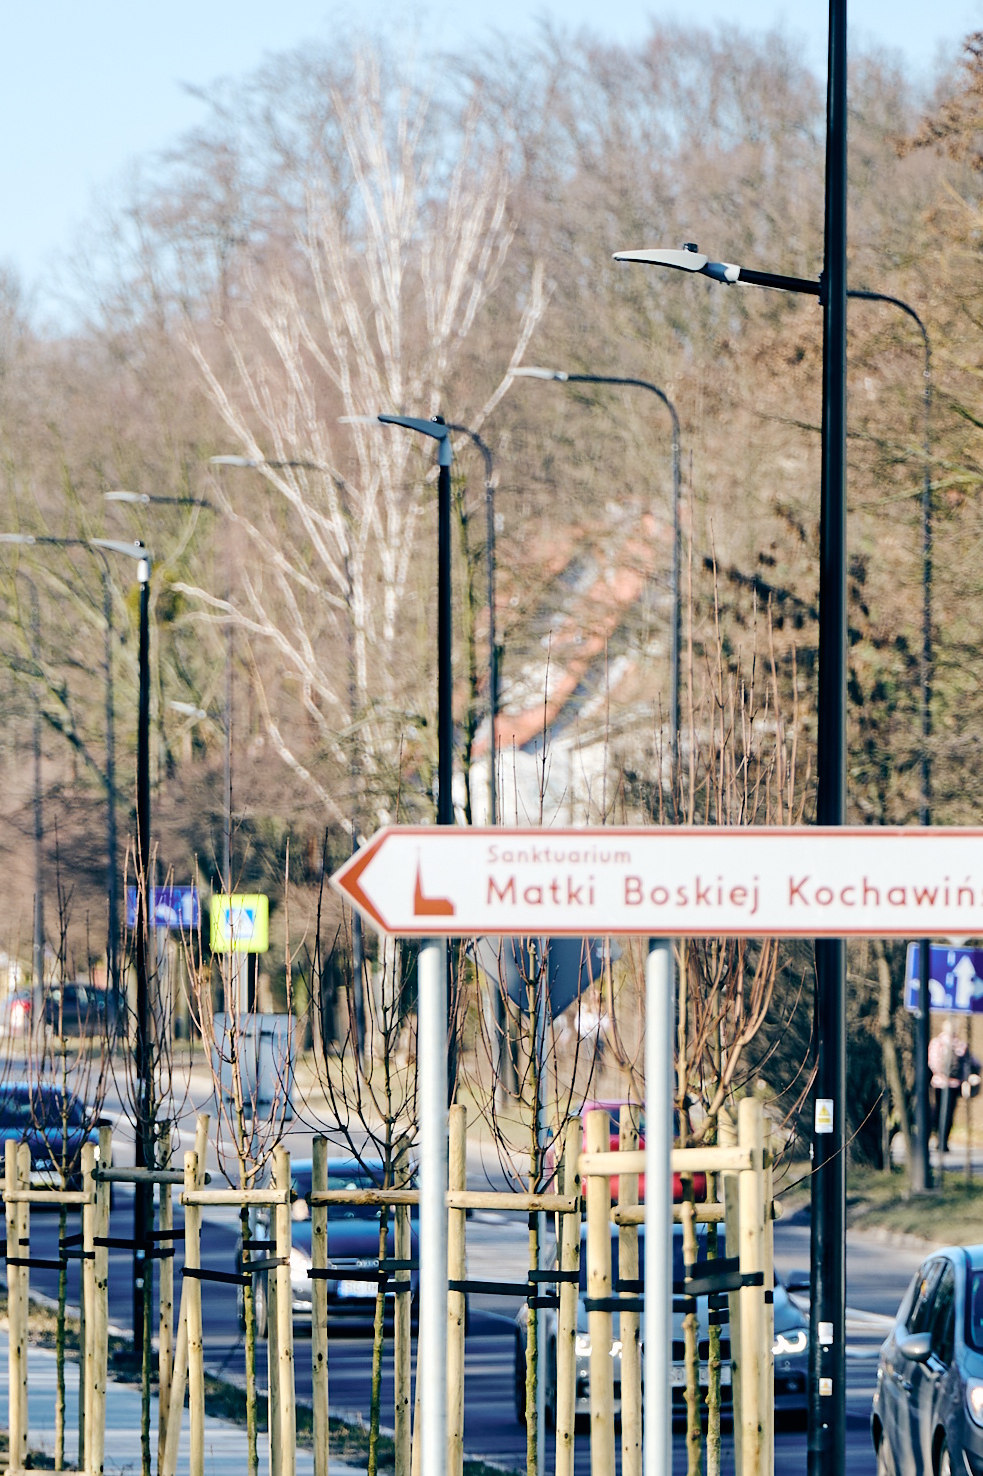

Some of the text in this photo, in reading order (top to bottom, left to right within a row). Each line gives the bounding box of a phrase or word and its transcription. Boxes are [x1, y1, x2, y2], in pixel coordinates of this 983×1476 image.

[487, 845, 631, 864] Sanktuarium
[486, 874, 983, 916] Matki Boskiej Kochawiń
